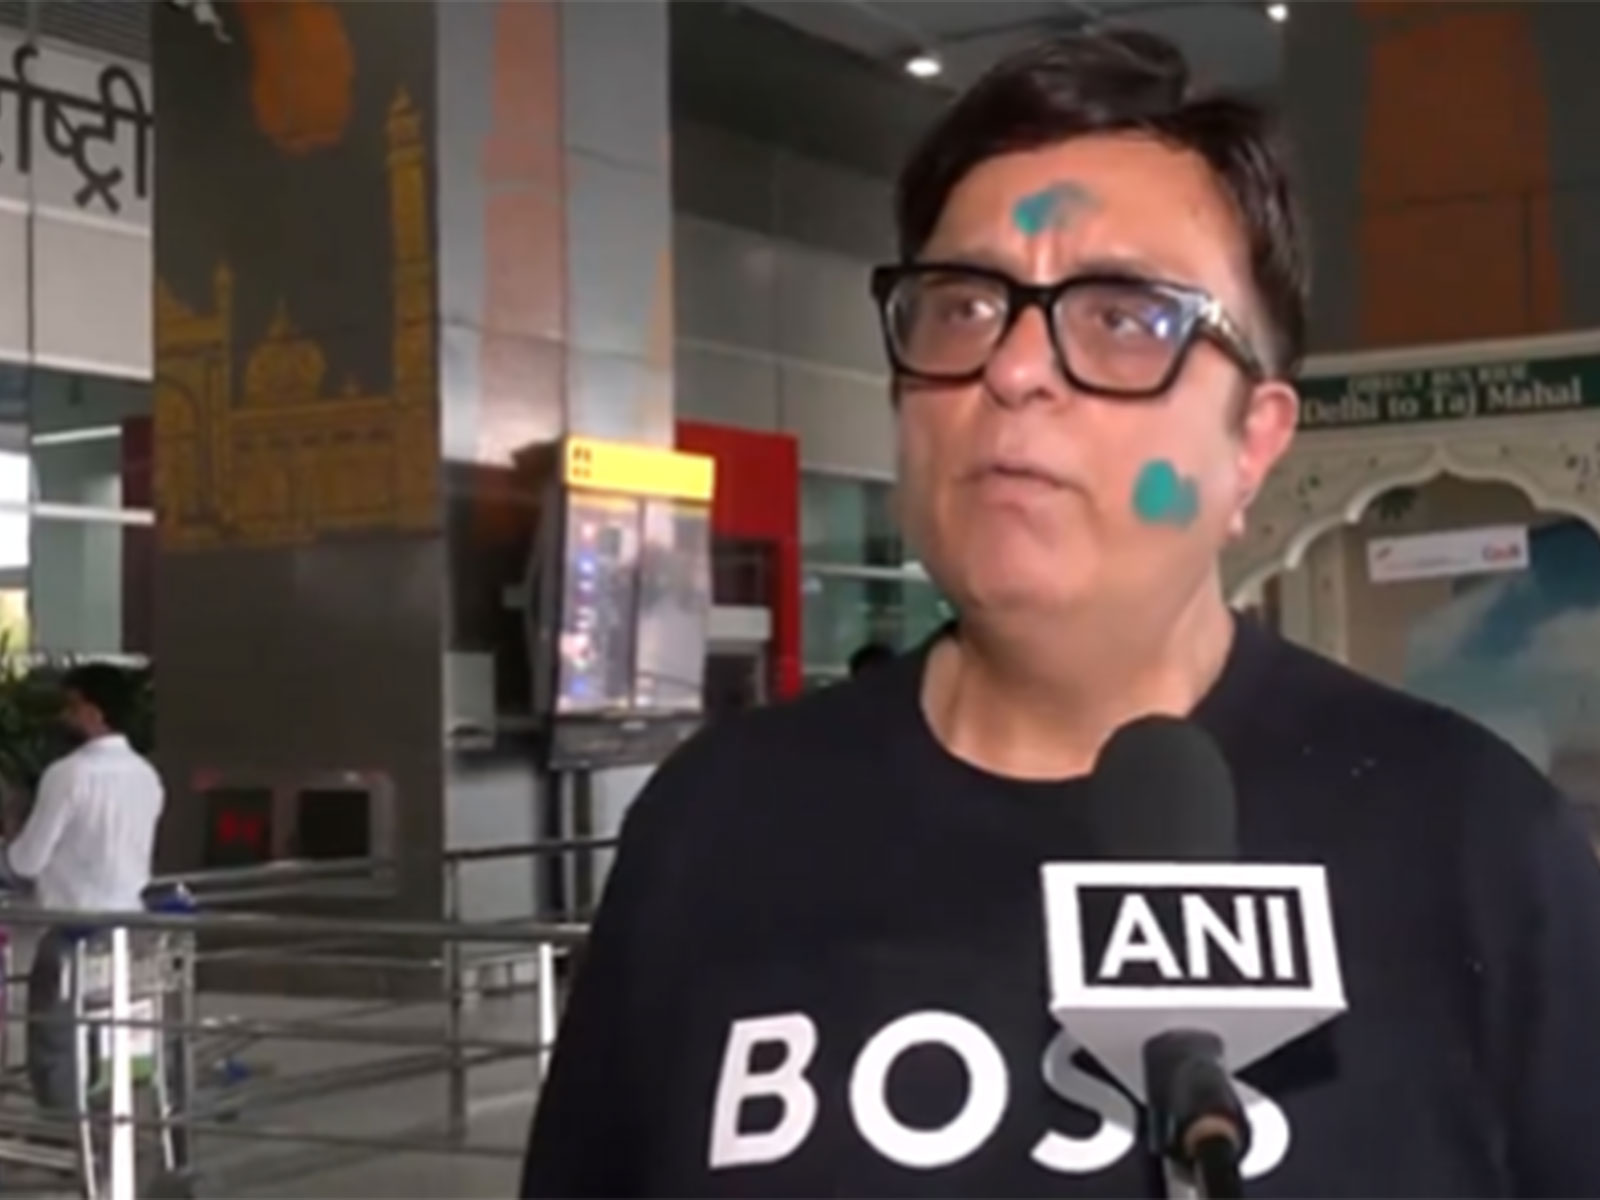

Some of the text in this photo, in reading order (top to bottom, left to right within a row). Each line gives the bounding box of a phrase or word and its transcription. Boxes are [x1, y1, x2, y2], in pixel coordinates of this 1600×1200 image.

[1302, 376, 1582, 424] Delhi to Taj Mahal
[1098, 893, 1296, 980] ANI
